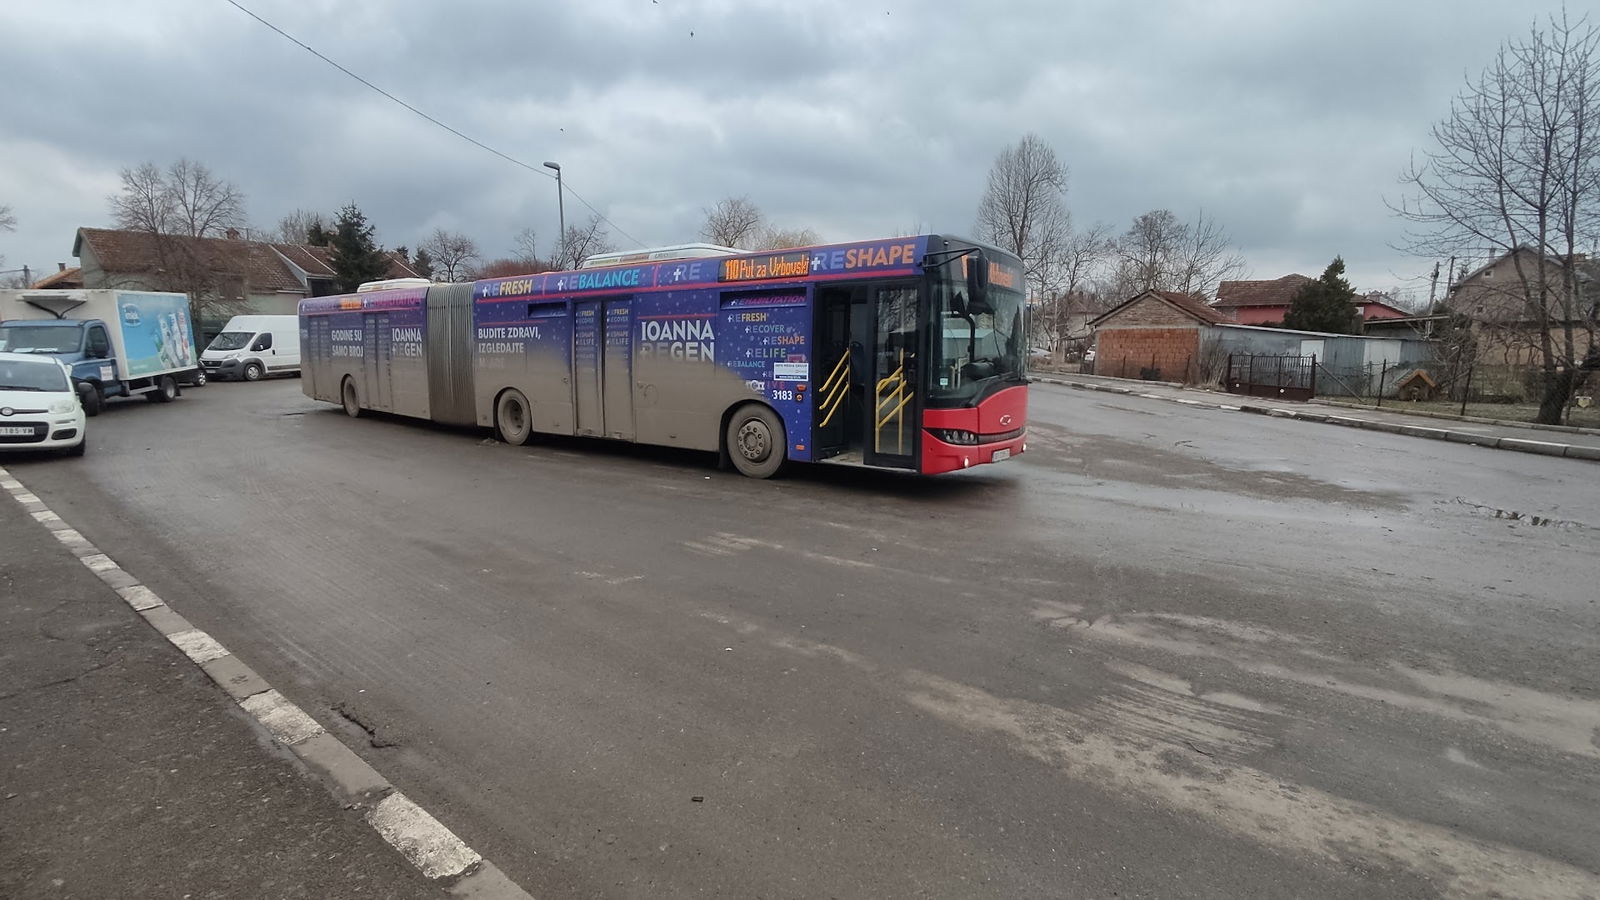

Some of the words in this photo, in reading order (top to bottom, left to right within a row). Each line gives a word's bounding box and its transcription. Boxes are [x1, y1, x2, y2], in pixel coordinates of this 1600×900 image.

[725, 258, 739, 280] 110
[740, 258, 754, 279] Put
[756, 265, 767, 277] za
[331, 330, 354, 341] GODINE
[354, 330, 362, 341] SU
[392, 328, 422, 341] IOANNA
[478, 328, 505, 339] BUDITE
[507, 327, 541, 339] ZDRAVI,
[641, 319, 715, 341] IOANNA
[332, 345, 348, 357] SAMO
[349, 345, 364, 357] BROJ
[478, 343, 524, 353] IZGLEDAJTE
[772, 390, 792, 400] 3183
